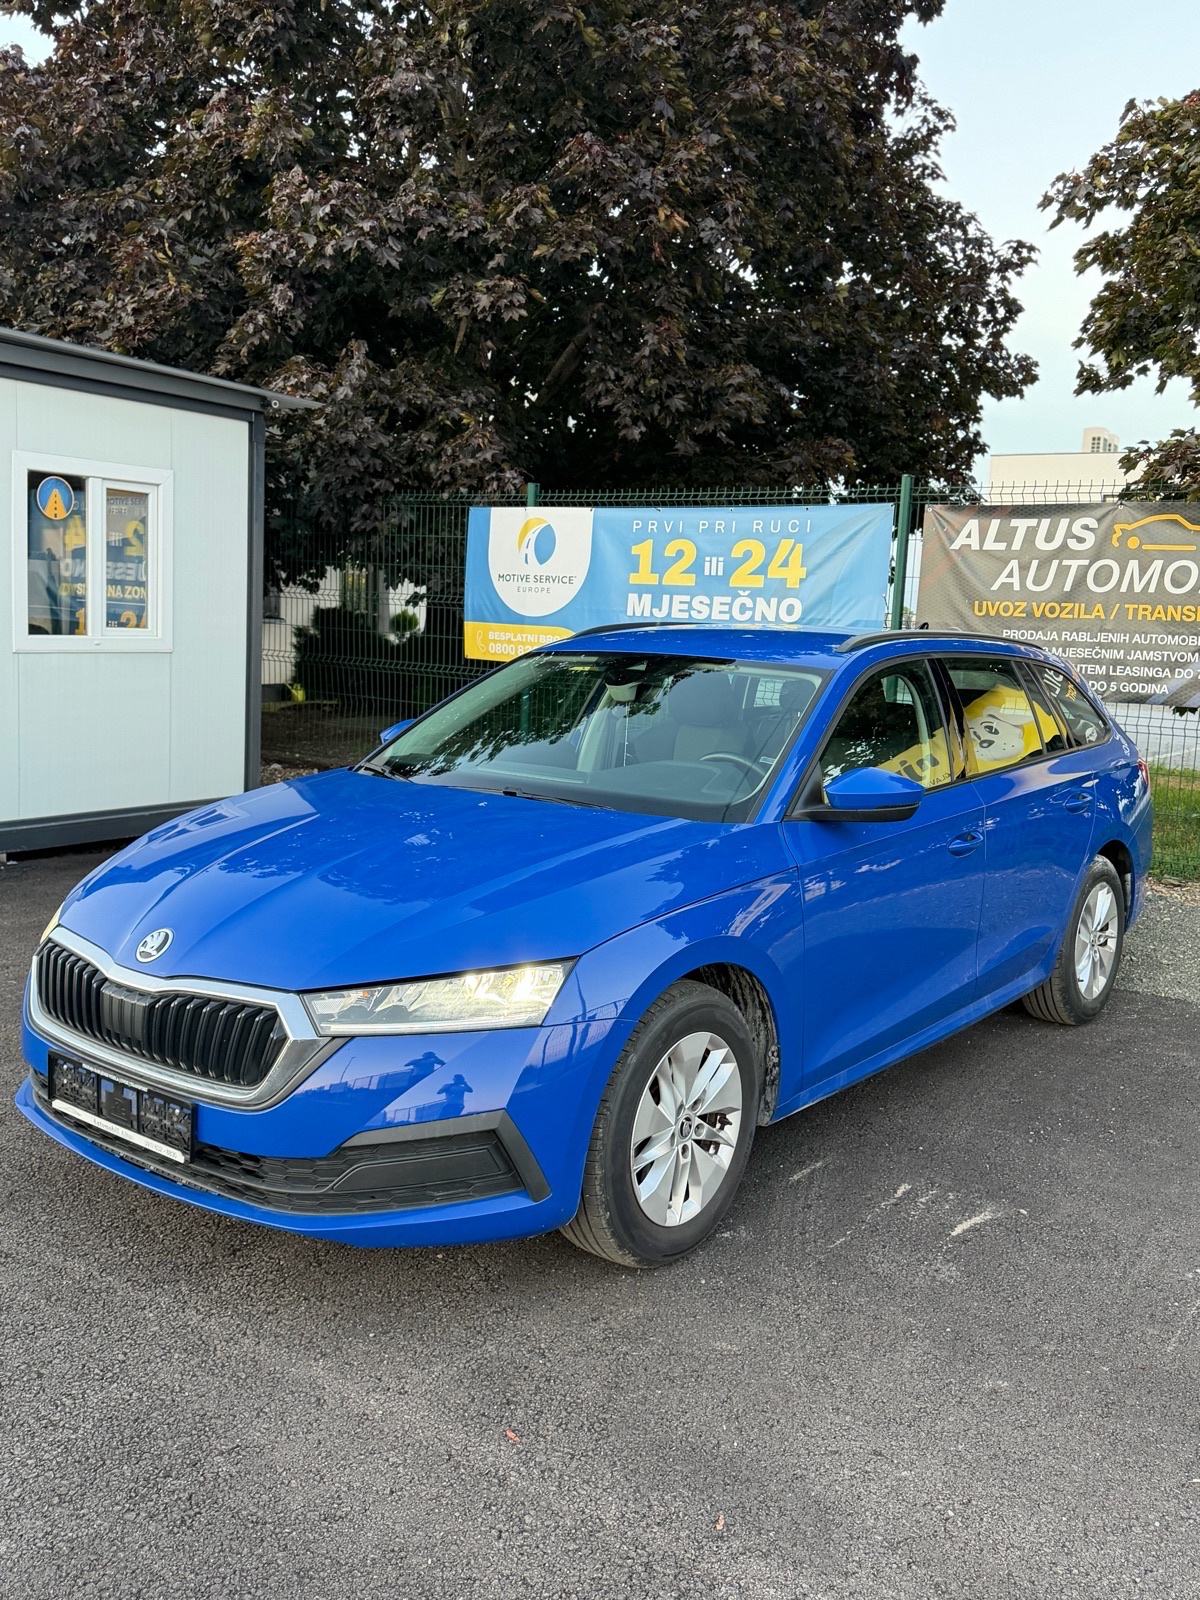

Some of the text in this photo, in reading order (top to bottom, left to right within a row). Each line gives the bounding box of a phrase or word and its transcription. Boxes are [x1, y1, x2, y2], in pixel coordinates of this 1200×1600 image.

[632, 519, 812, 533] PRVI PRI RUCI
[950, 517, 1099, 551] ALTUS
[628, 537, 807, 589] 12 ili 24
[497, 573, 575, 585] MOTIVE SERVICE
[991, 559, 1200, 595] AUTOMO
[517, 586, 551, 594] EUROPE
[626, 590, 803, 623] MJESEČNO
[973, 600, 1027, 618] UVOZ
[1032, 602, 1105, 620] VOZILA
[1125, 604, 1200, 622] TRANS
[488, 631, 538, 643] BESPLATNI
[1002, 629, 1058, 642] PRODAJA
[1061, 631, 1129, 644] RABLJENIH
[488, 642, 516, 656] 0800
[1052, 645, 1124, 660] MJESEČNIM
[1127, 650, 1199, 663] JAMSTVOM
[1109, 666, 1171, 679] LEASINGA
[1174, 668, 1194, 680] DO
[1088, 681, 1107, 692] DO
[1109, 682, 1117, 692] 5
[1120, 682, 1169, 695] GODINA
